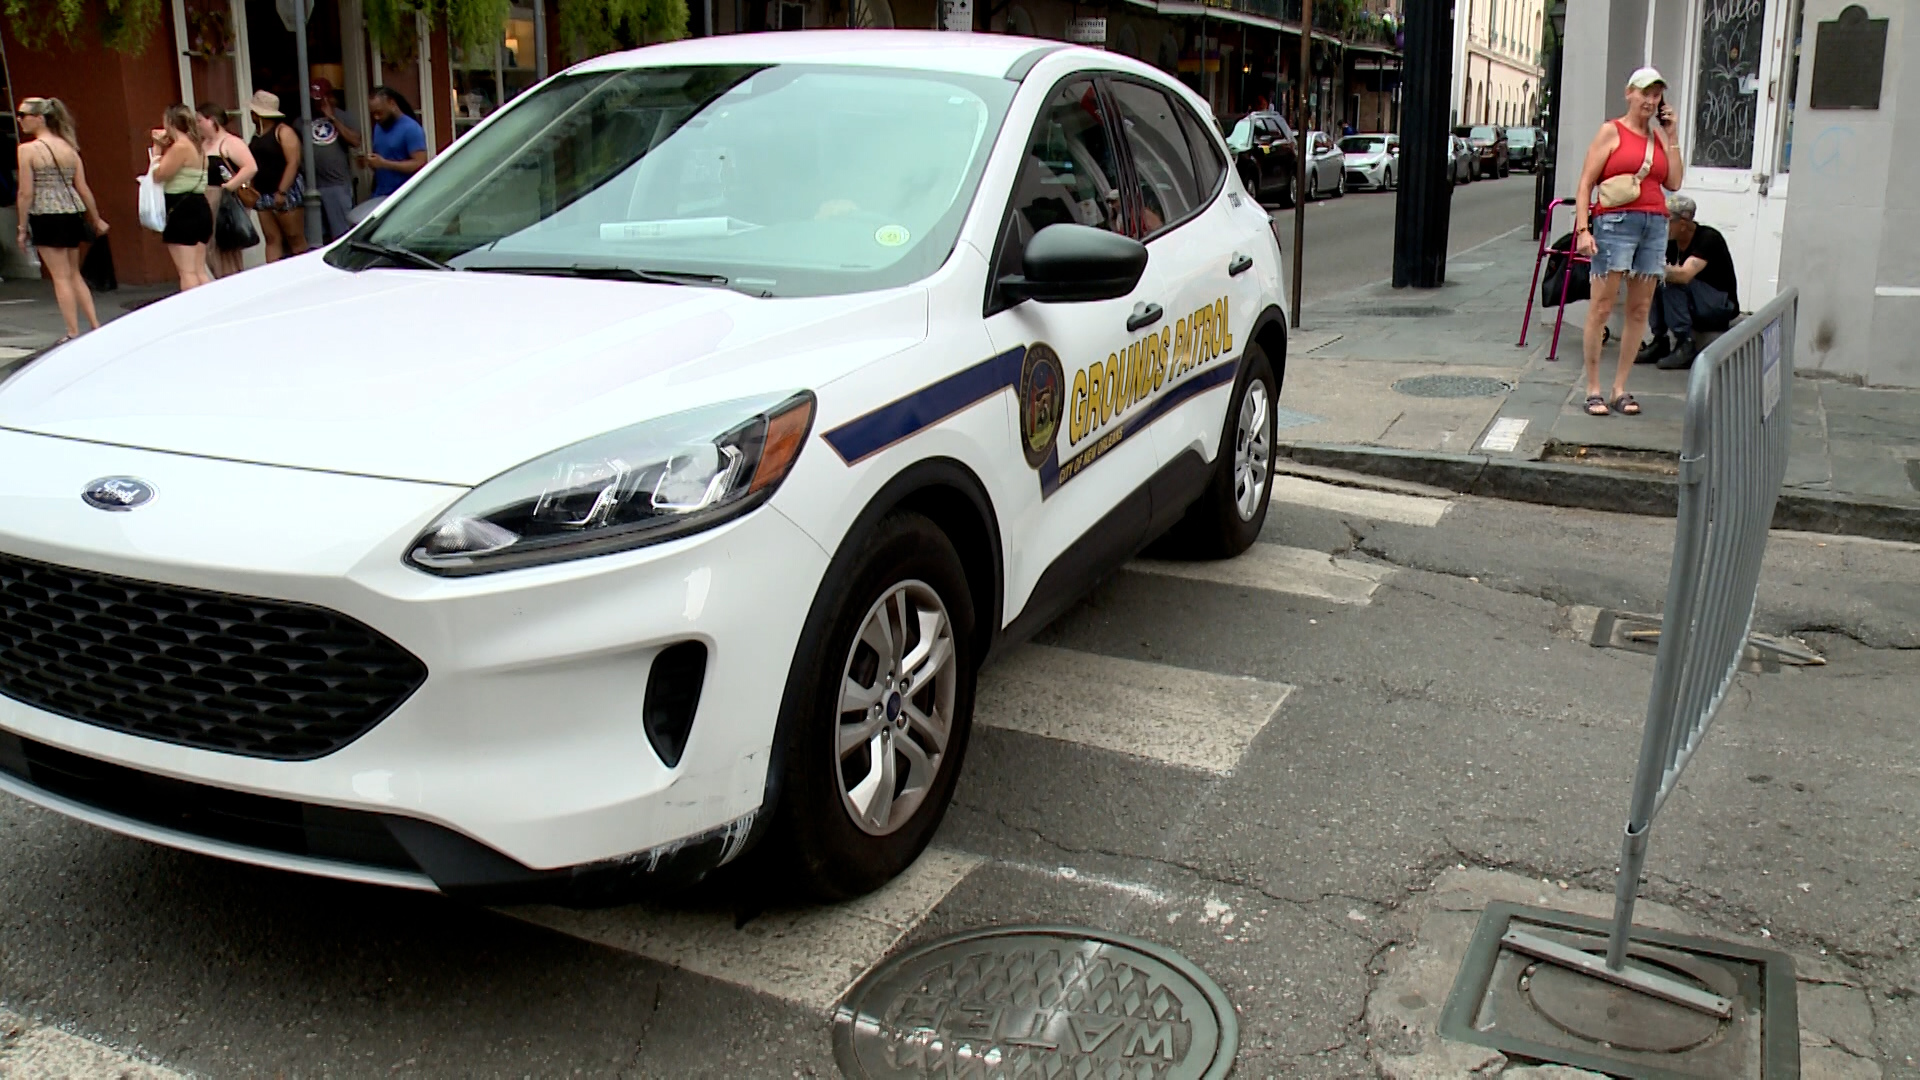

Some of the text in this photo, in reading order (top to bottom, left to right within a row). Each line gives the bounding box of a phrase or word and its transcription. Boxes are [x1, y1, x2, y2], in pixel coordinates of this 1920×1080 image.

[1070, 326, 1170, 447] GROUNDS
[1168, 296, 1233, 382] PATROL
[1059, 426, 1123, 484] CITY OF NEW ORLEANS
[95, 479, 141, 504] Ford
[893, 995, 1175, 1062] WATER
